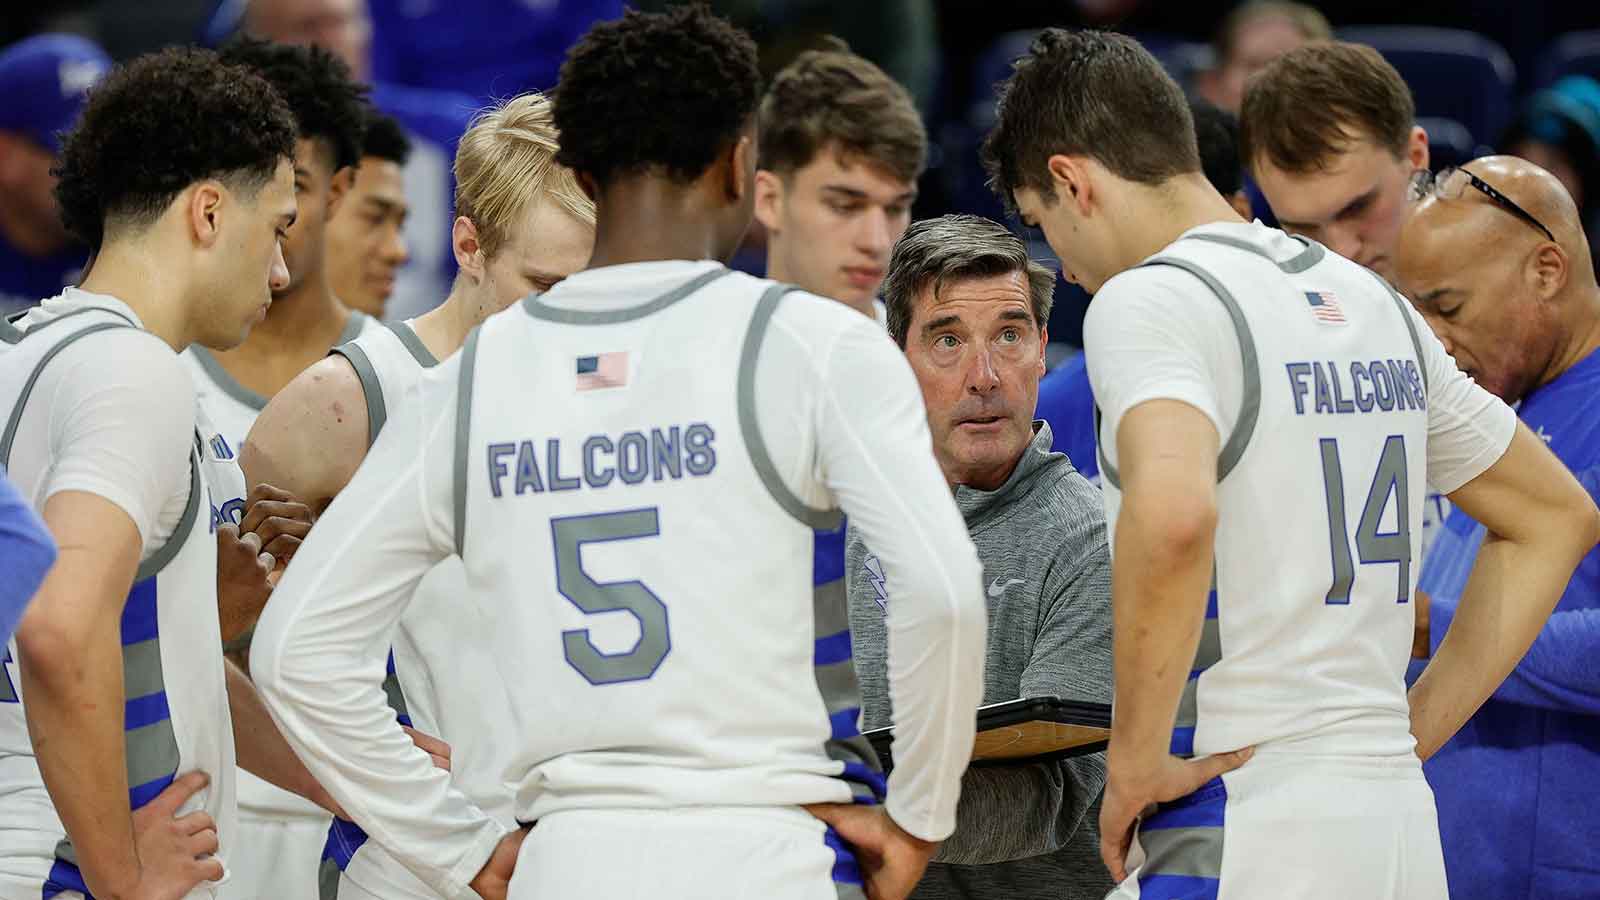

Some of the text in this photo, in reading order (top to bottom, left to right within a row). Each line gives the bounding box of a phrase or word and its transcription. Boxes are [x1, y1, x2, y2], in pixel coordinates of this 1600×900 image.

[1286, 359, 1426, 414] FALCONS
[488, 423, 717, 498] FALCONS
[1319, 435, 1411, 605] 14
[550, 507, 671, 686] 5
